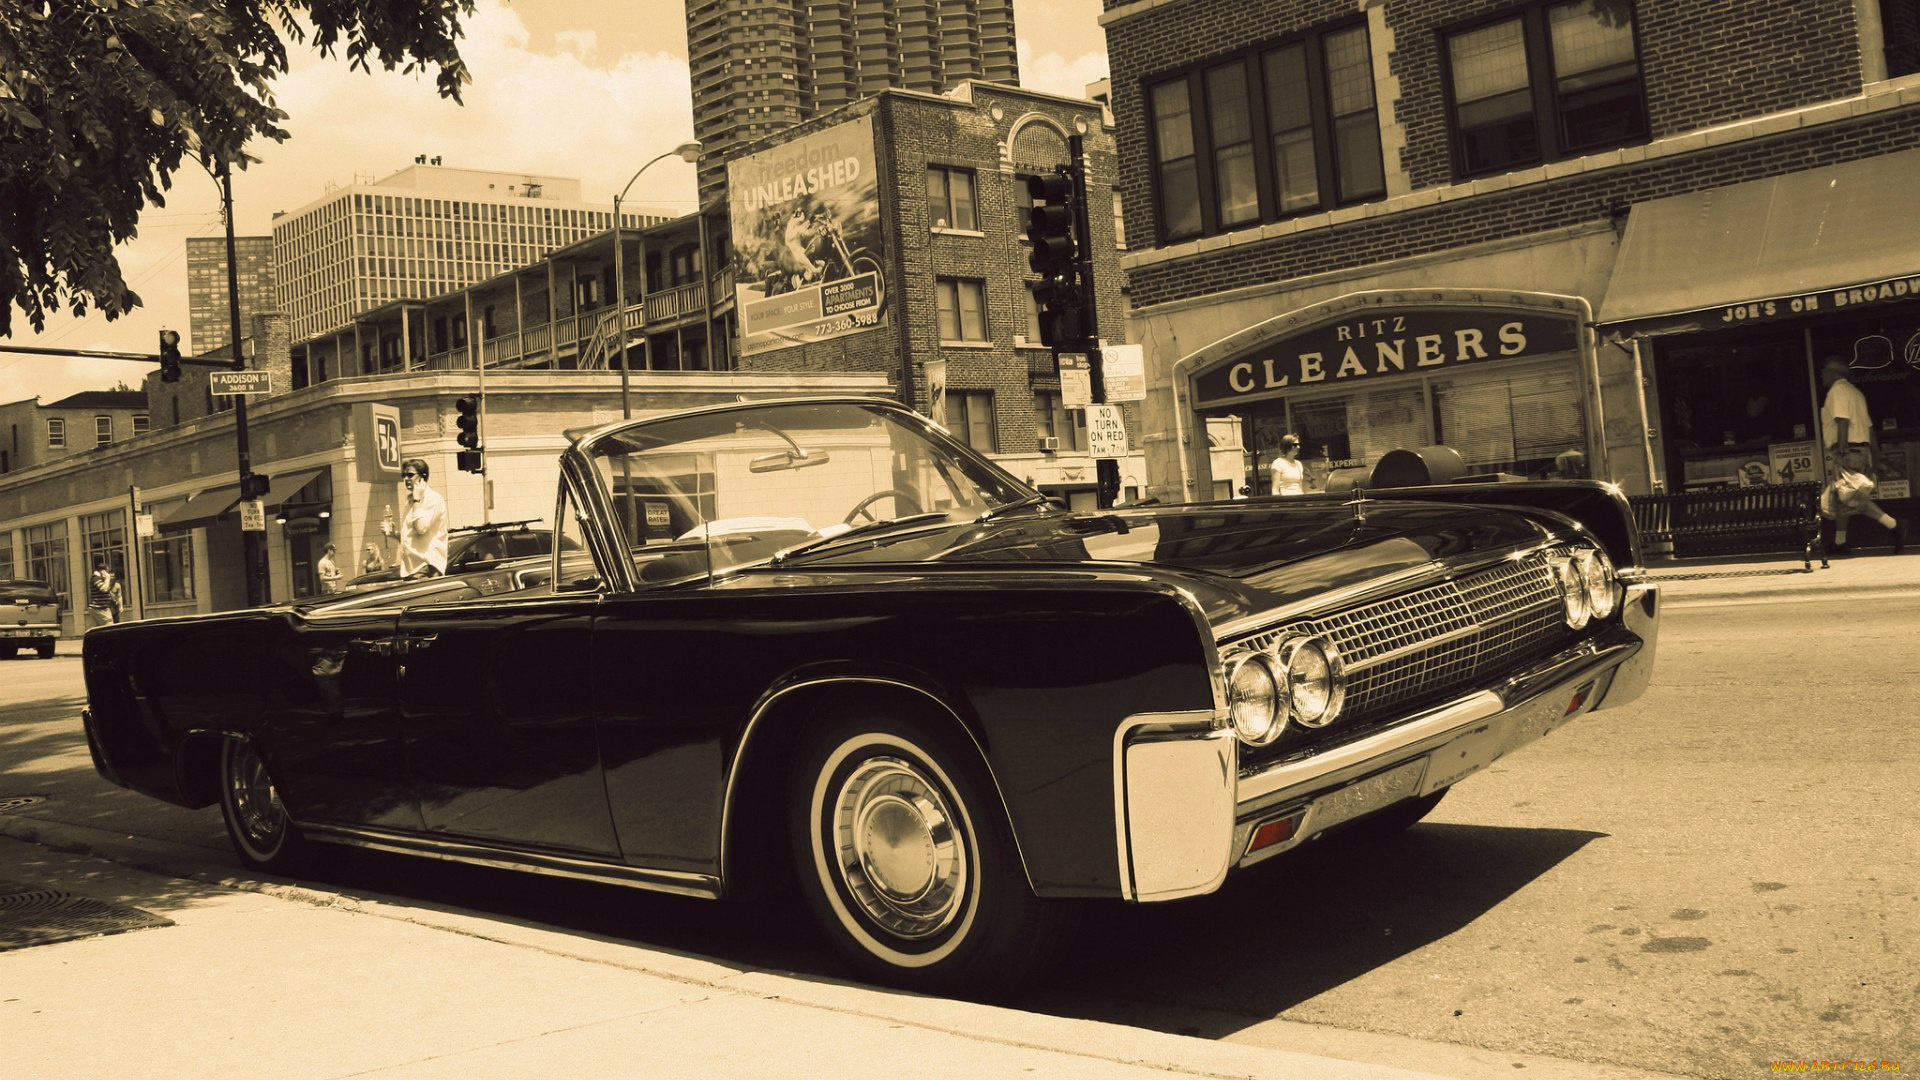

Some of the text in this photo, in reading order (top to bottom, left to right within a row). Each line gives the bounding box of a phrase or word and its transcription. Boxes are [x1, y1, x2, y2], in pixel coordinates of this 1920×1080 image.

[743, 156, 860, 212] UNLEASHED
[824, 282, 854, 295] OVER 3000
[825, 286, 874, 306] APARTMENTS
[783, 304, 799, 314] YOUR
[826, 297, 871, 314] TO CHOOSE FROM
[1721, 301, 1776, 322] JOE'S
[1790, 295, 1818, 313] ON
[815, 312, 878, 336] 773-360-5988
[1337, 316, 1407, 342] RITZ
[1228, 321, 1528, 393] CLEANERS
[220, 373, 260, 384] ADDISON
[1099, 408, 1111, 418] NO
[1095, 420, 1118, 429] TURN
[1090, 431, 1123, 441] ON RED
